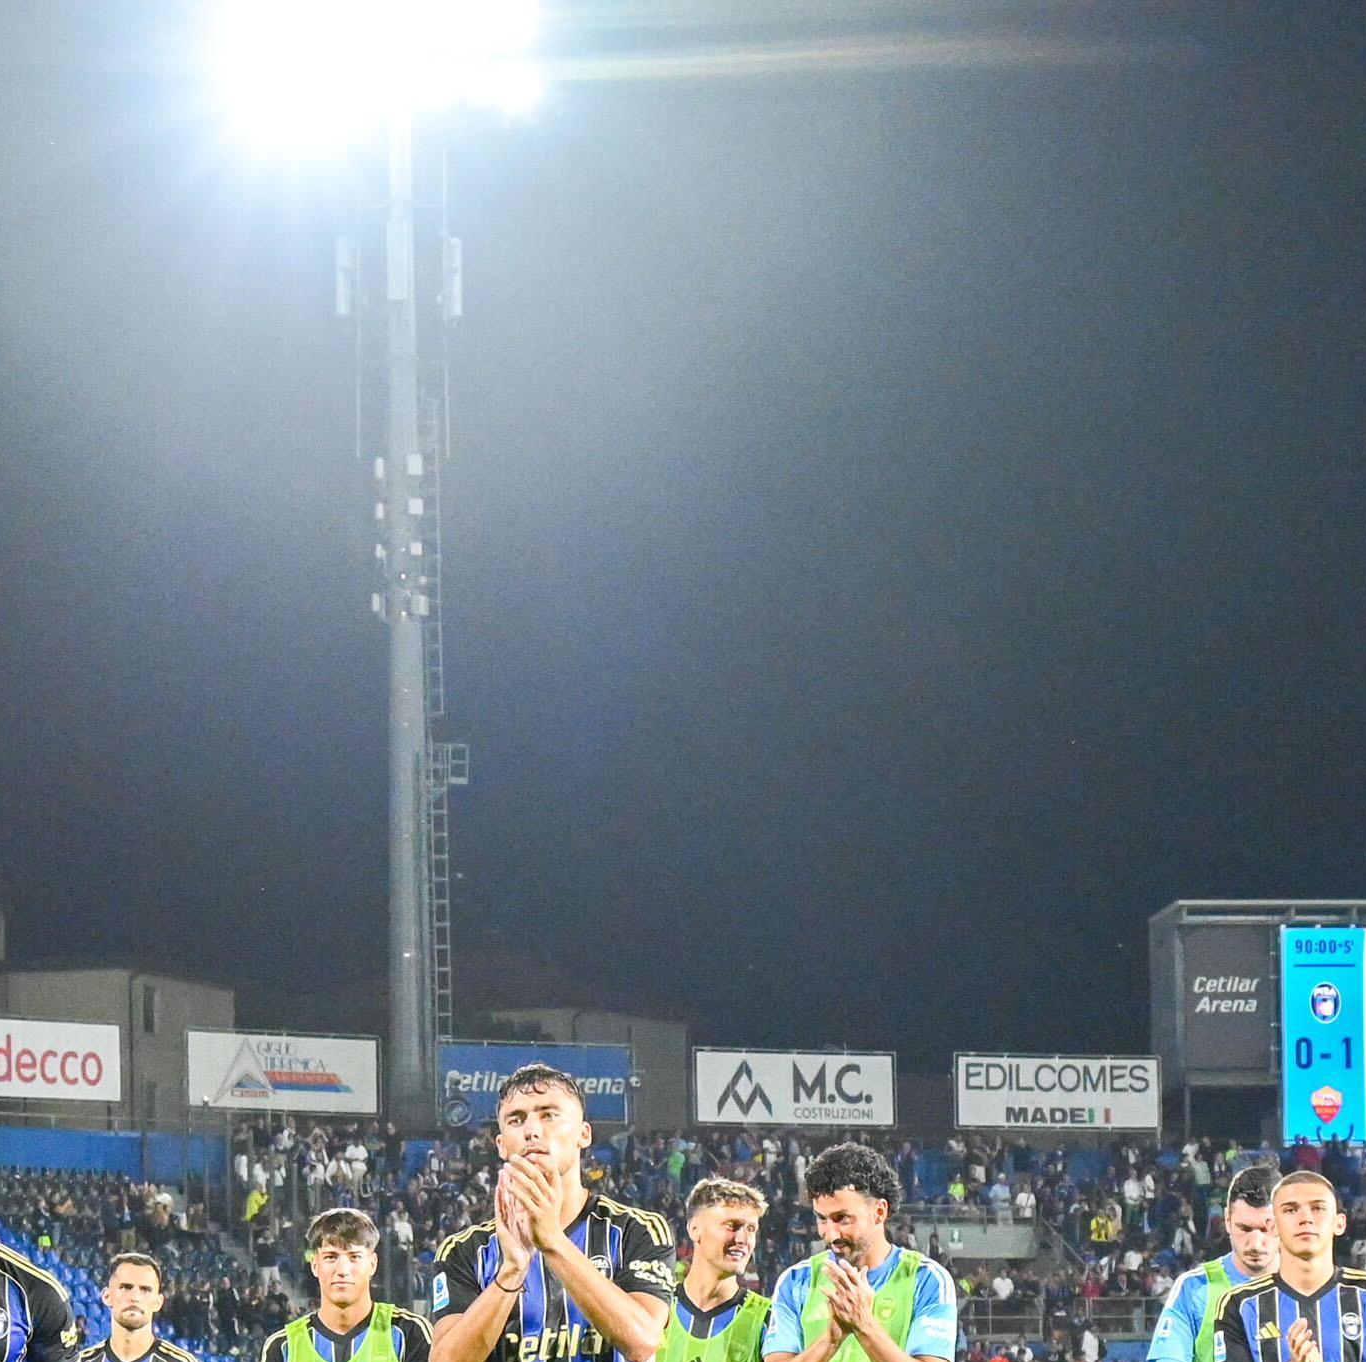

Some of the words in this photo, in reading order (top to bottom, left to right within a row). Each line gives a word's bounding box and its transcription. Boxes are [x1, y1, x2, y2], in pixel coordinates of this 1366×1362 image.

[1193, 976, 1261, 993] Cetilar
[1195, 996, 1258, 1013] Arena
[1295, 1037, 1313, 1070] 0
[1341, 1036, 1352, 1070] 1
[792, 1060, 874, 1105] M.C.
[964, 1062, 1151, 1093] EDILCOMES
[793, 1108, 874, 1120] COSTRUZIONI
